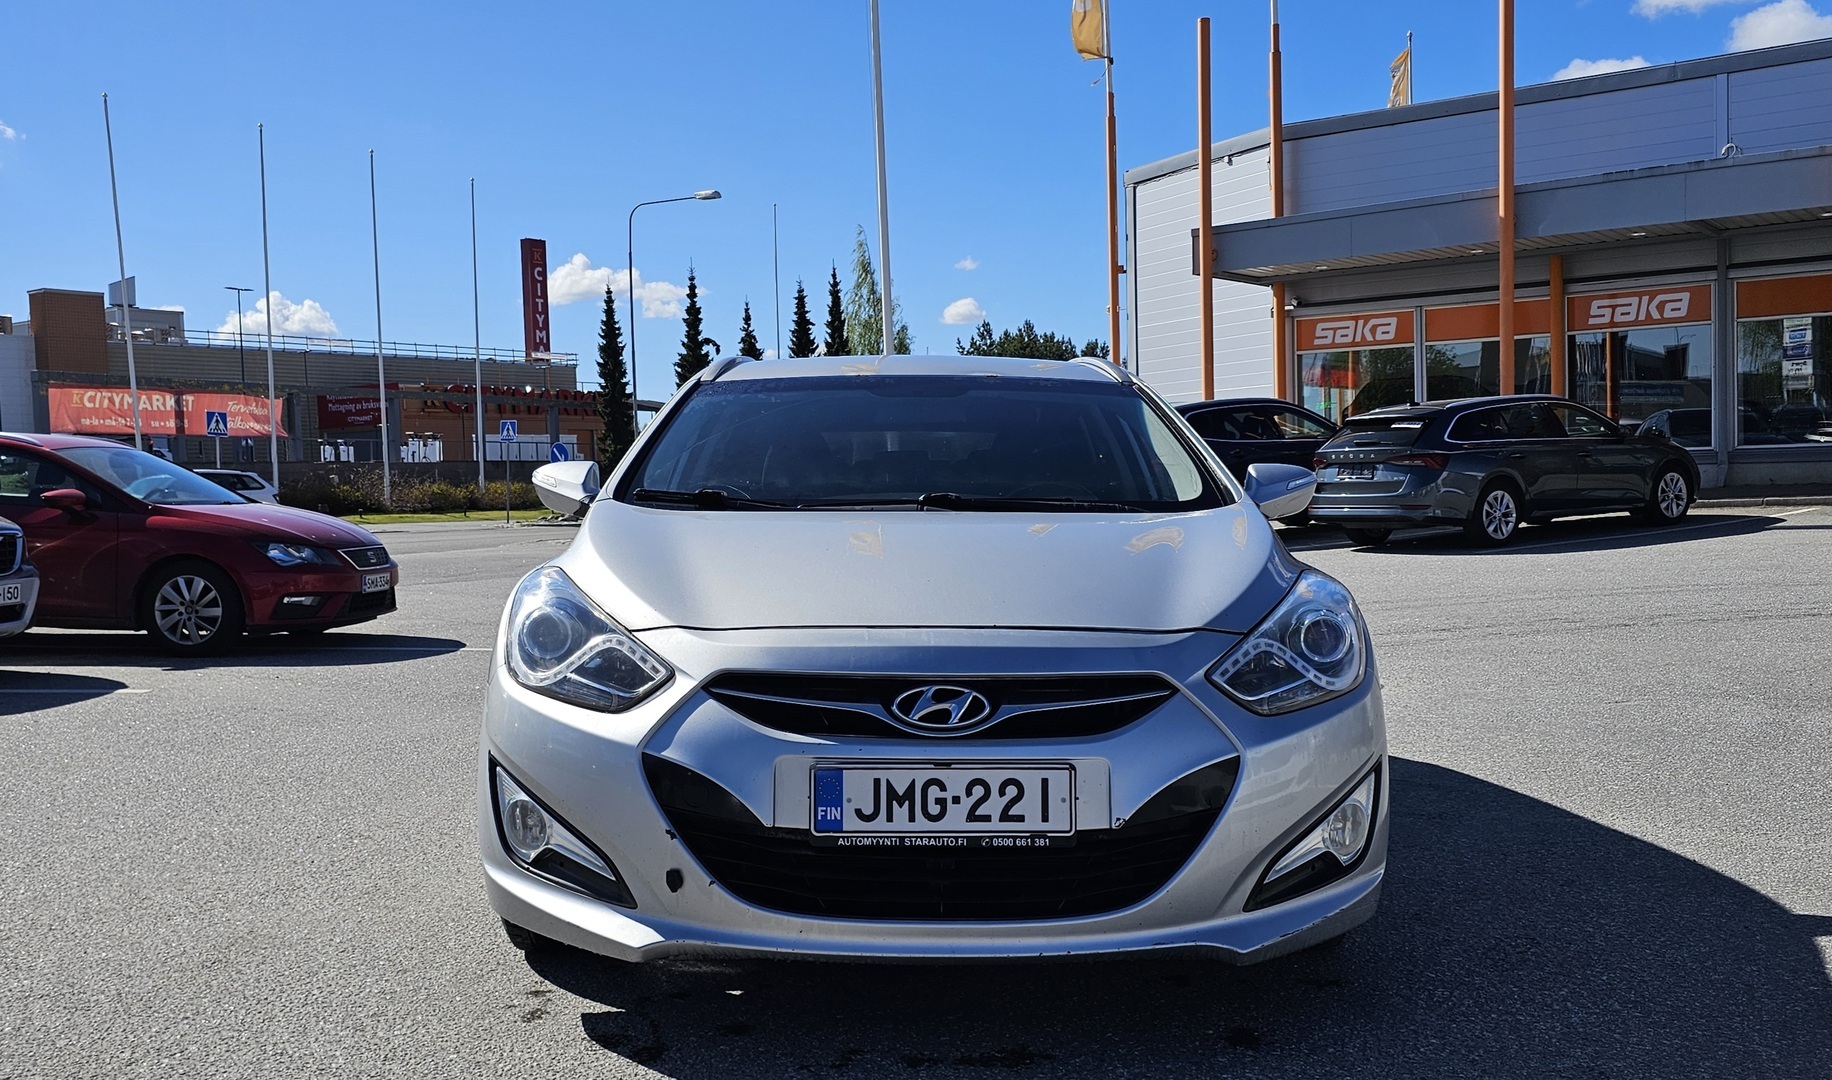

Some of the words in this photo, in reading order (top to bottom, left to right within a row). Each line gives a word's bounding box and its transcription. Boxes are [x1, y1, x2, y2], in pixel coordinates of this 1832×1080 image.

[854, 777, 1050, 823] JMG-221
[817, 806, 841, 820] FIN
[837, 837, 900, 846] AUTOMYYNTI
[904, 837, 967, 847] STARAUTO.FI
[992, 838, 1014, 846] 0500
[1016, 838, 1031, 846] 661
[1034, 838, 1050, 846] 381
